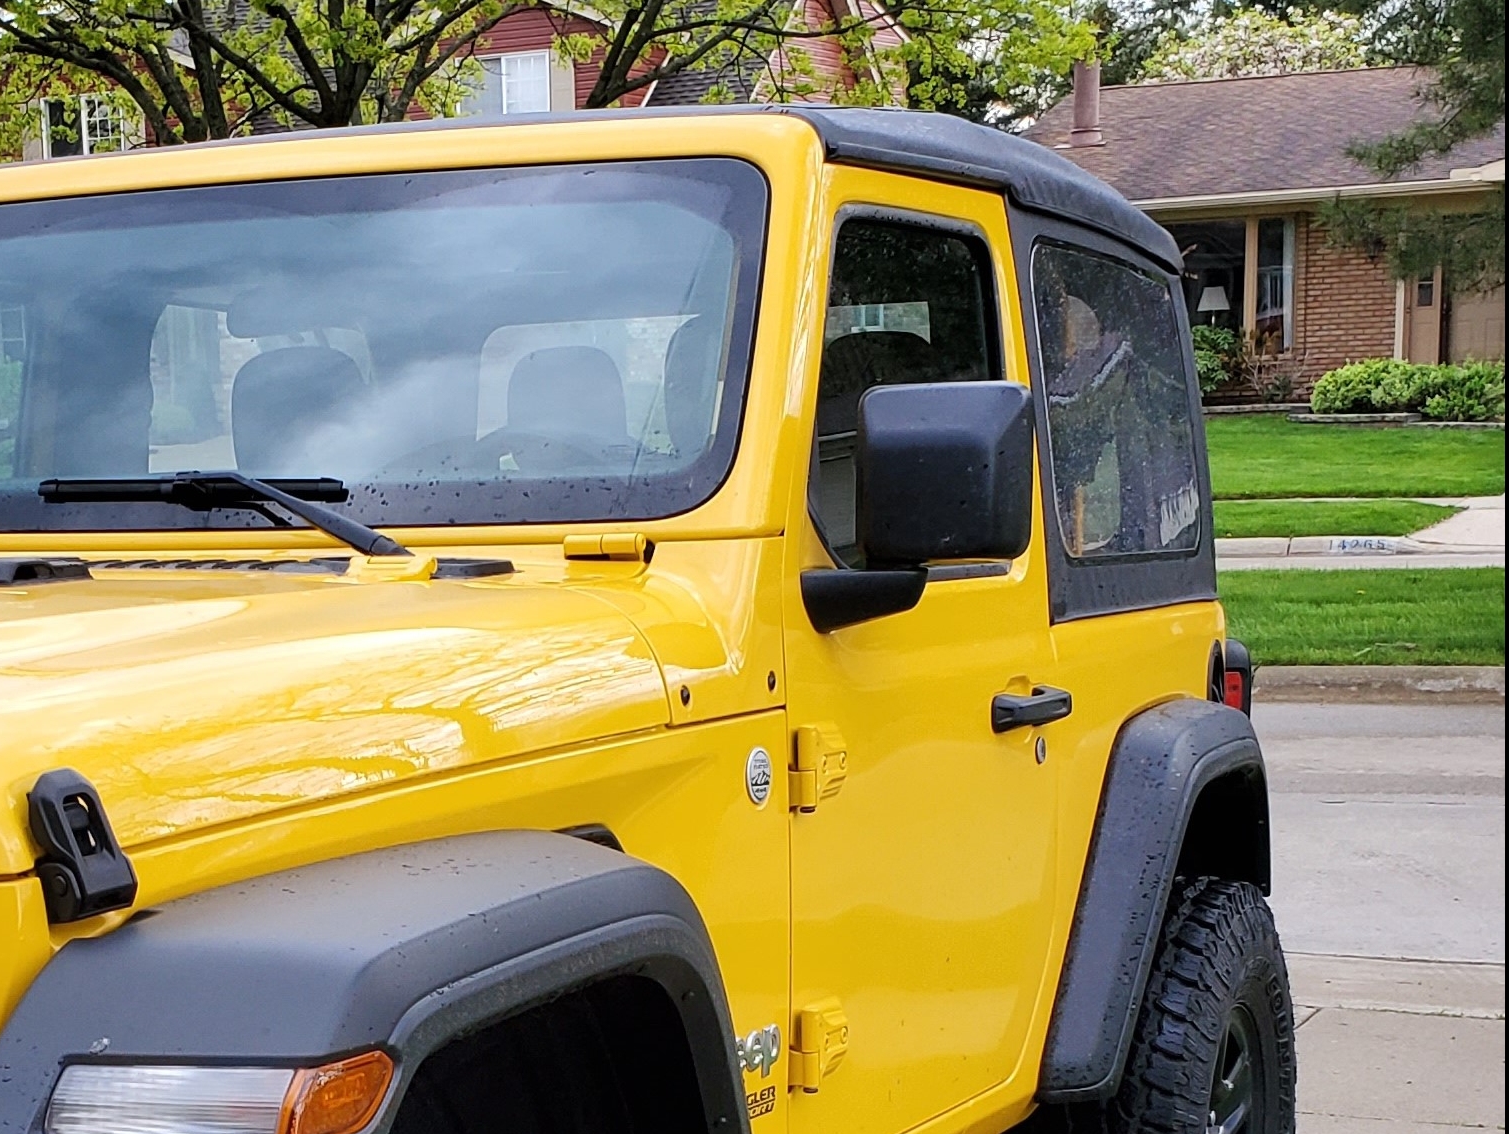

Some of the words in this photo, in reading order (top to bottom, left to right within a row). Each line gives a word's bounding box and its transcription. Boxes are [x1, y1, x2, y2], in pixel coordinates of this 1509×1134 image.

[735, 1023, 781, 1079] eep
[746, 1085, 776, 1107] GLER
[749, 1101, 775, 1120] ORT
